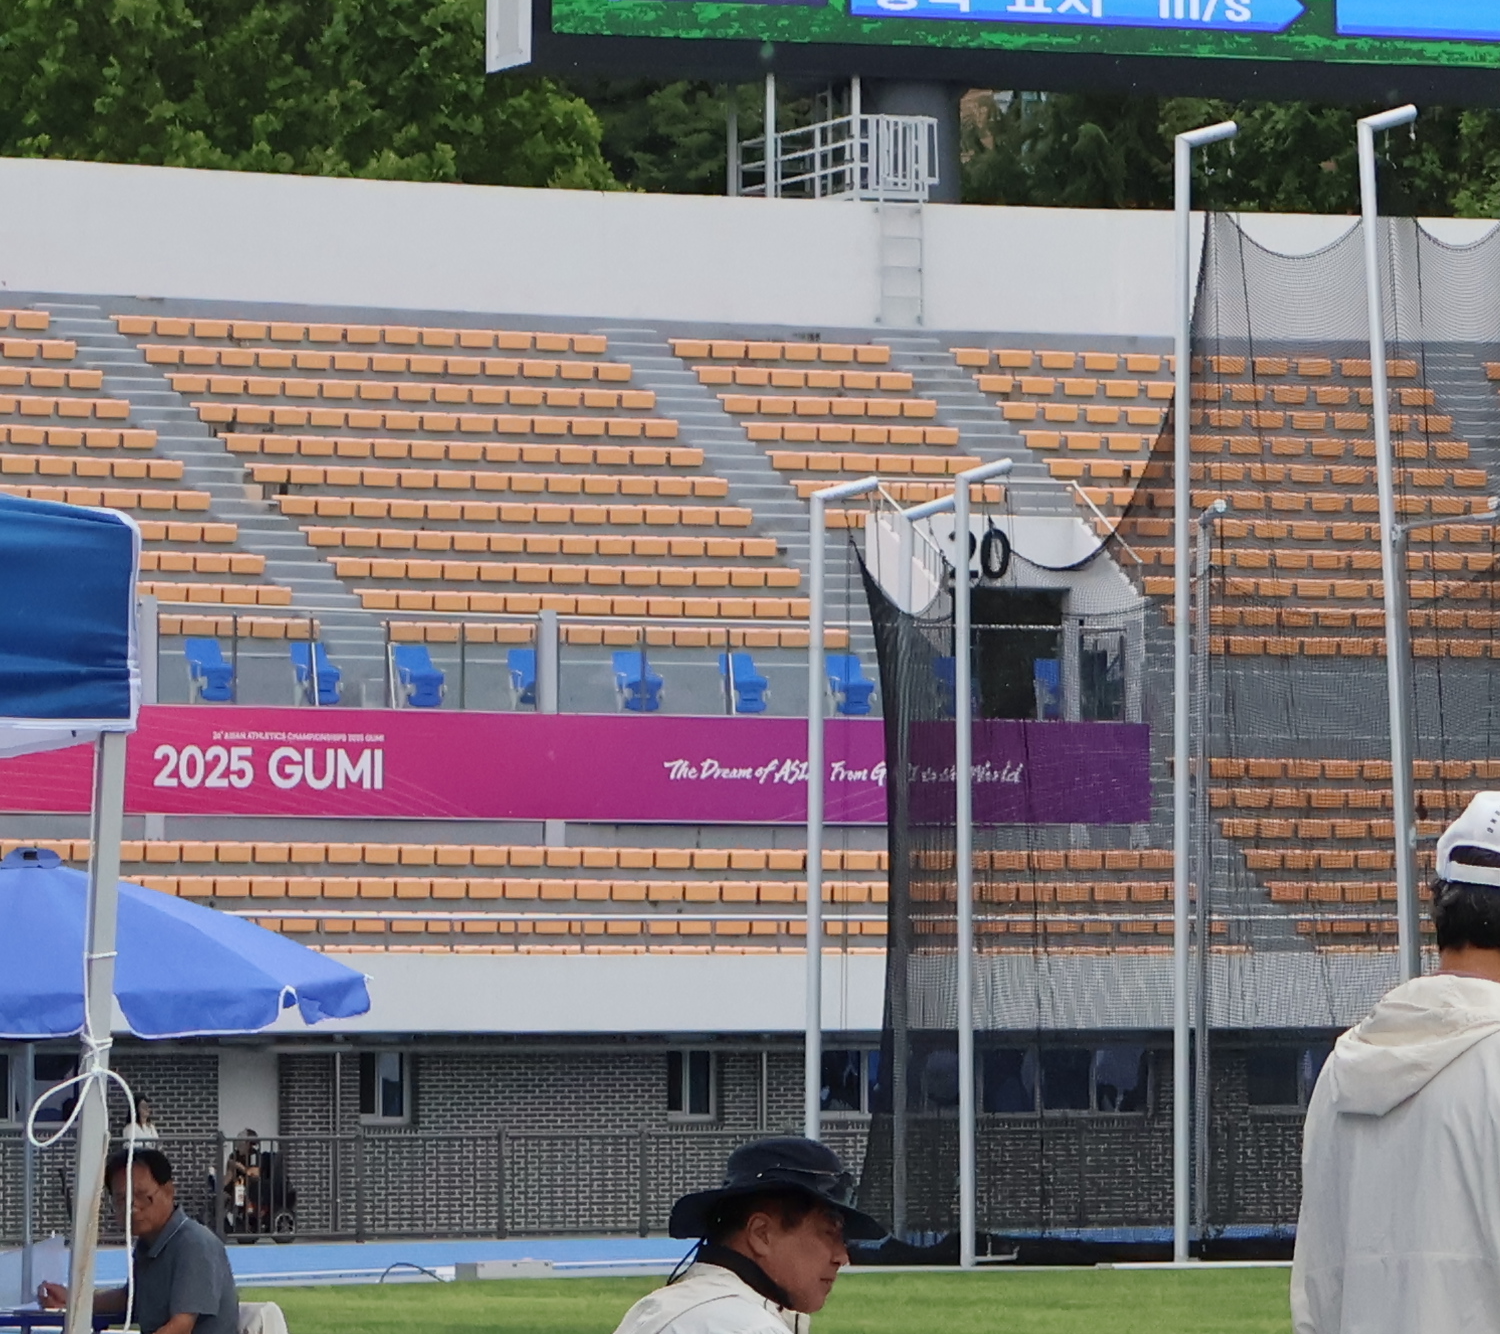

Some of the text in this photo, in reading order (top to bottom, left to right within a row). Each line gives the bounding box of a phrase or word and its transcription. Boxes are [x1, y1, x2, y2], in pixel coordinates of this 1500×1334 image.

[153, 744, 384, 790] 2025 GUMI
[663, 759, 698, 780] The
[700, 758, 752, 780] Dream
[754, 759, 779, 784] of
[773, 758, 810, 784] ASI
[830, 760, 867, 782] From
